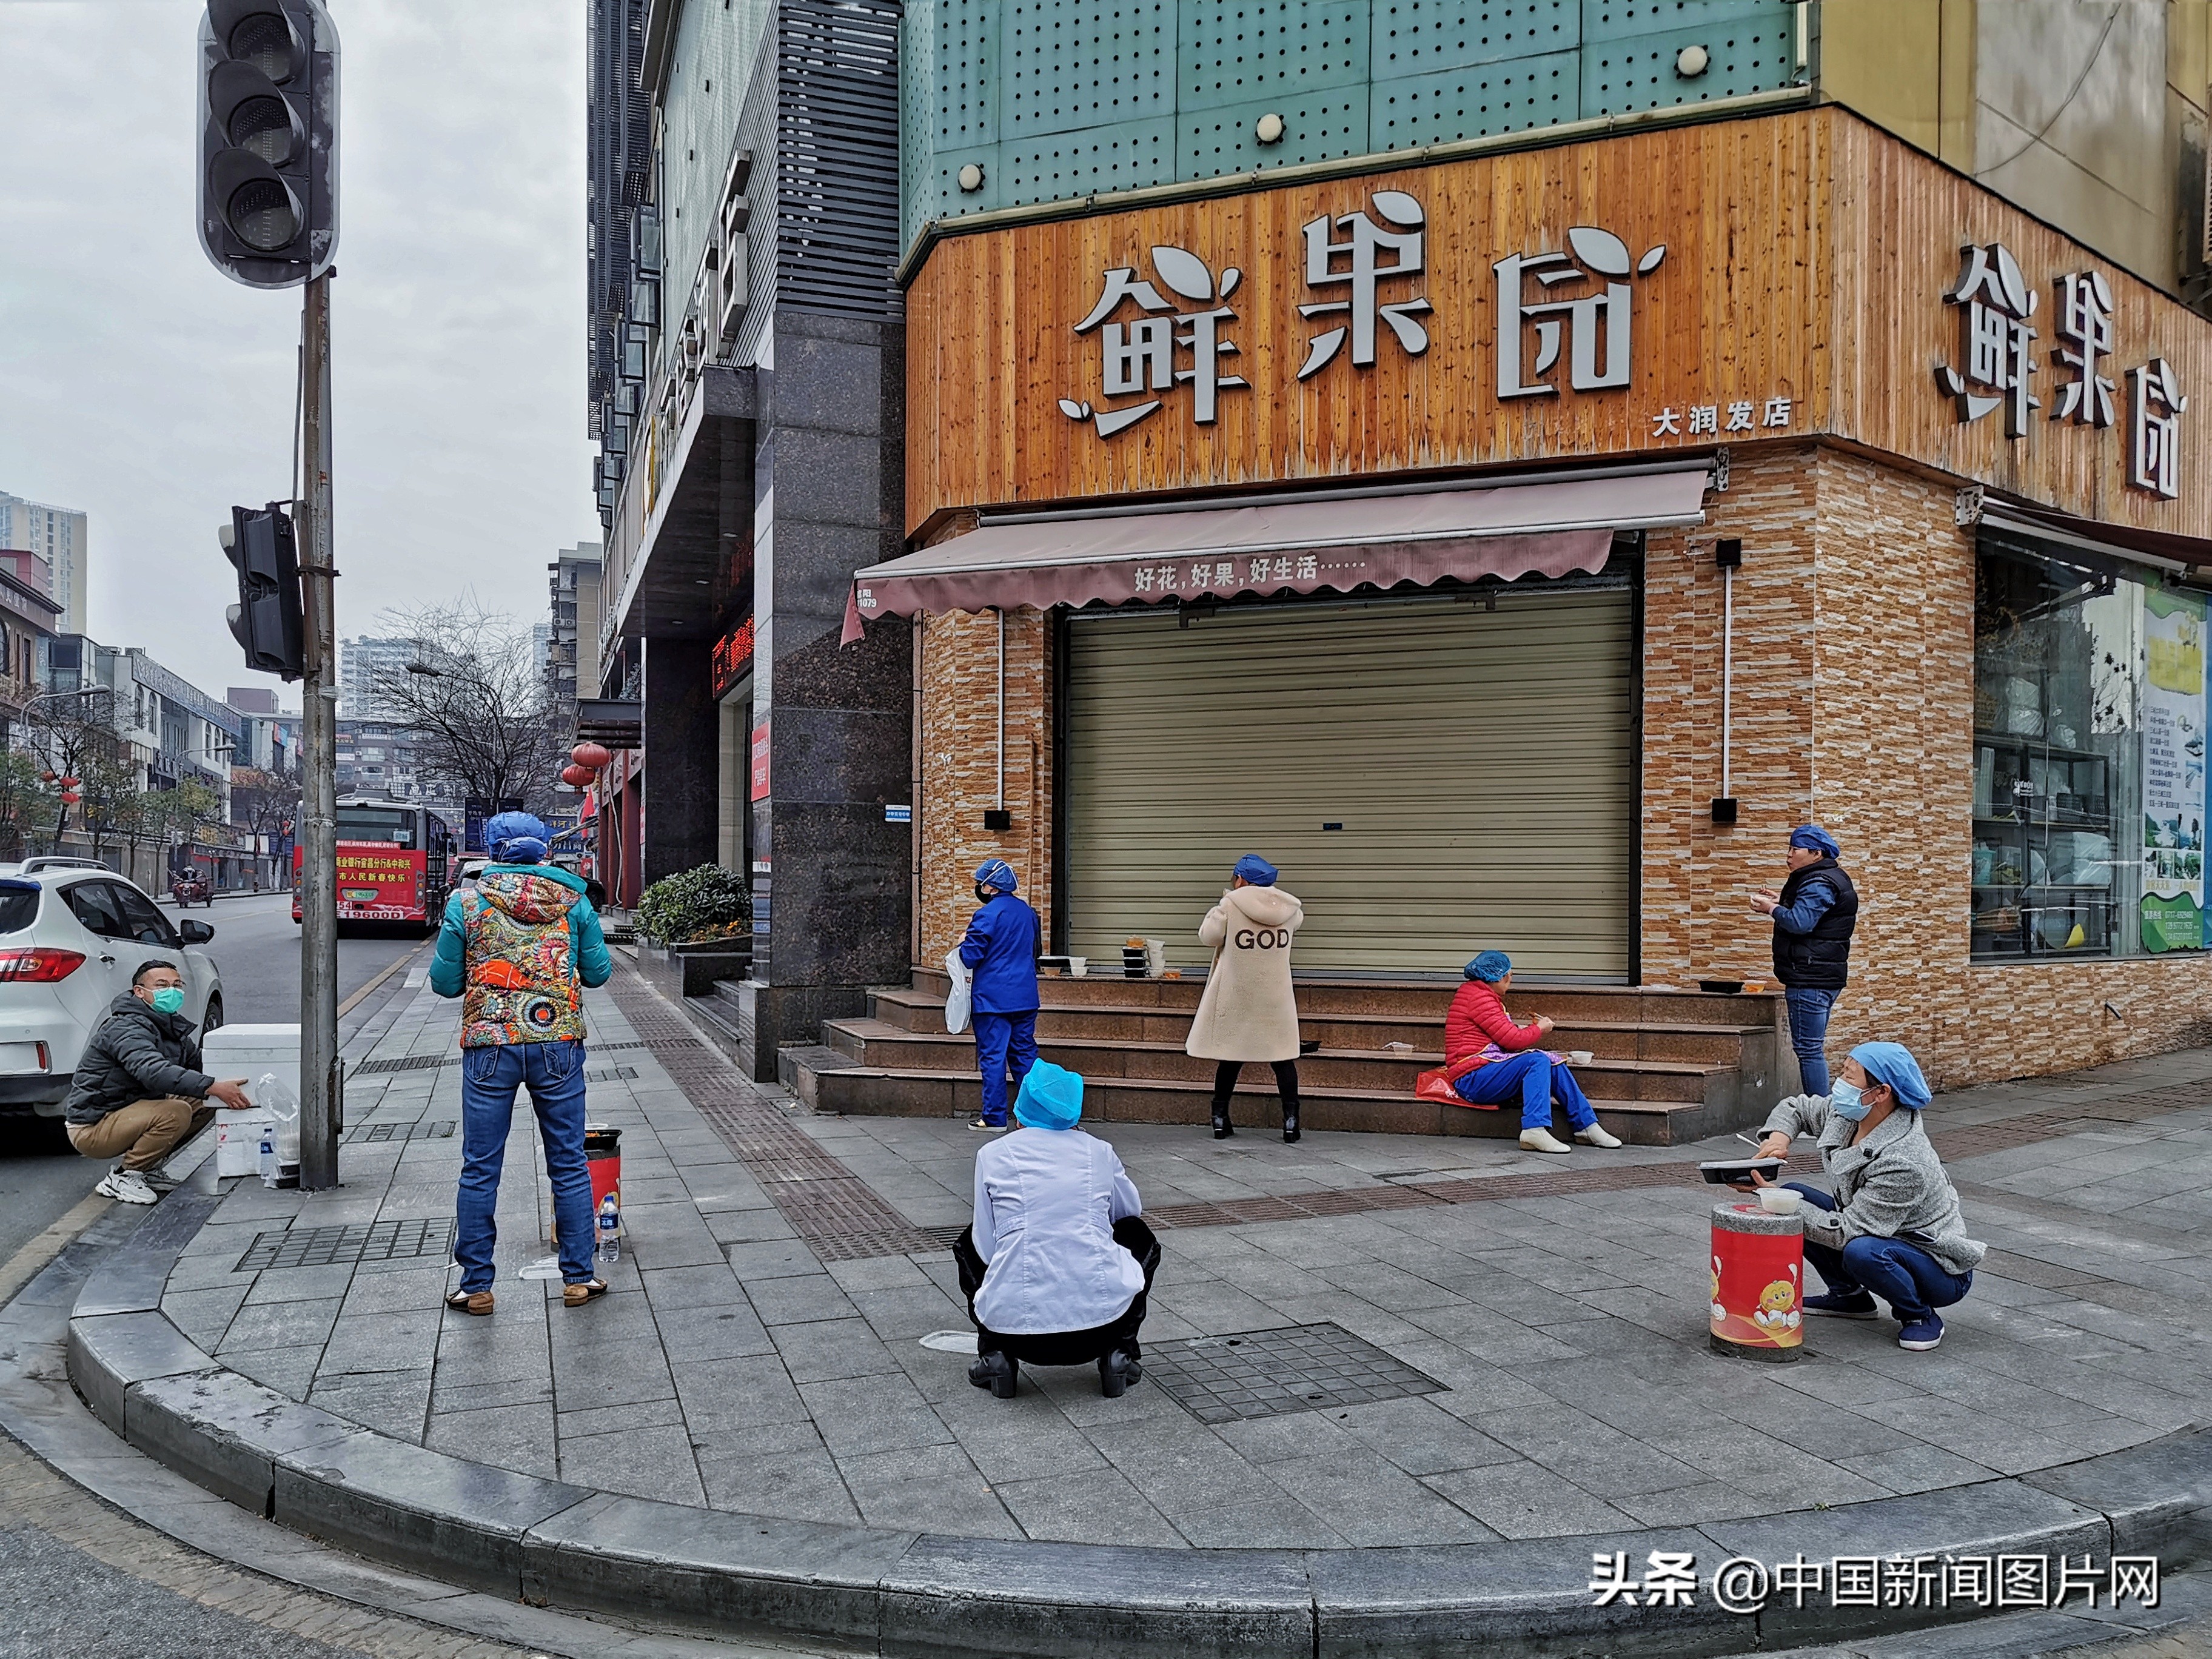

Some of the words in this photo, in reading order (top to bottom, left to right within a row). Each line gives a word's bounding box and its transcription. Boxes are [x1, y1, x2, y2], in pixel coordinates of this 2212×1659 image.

[1057, 190, 1666, 440] 鲜果园
[1934, 243, 2188, 500] 鲜果园
[1652, 397, 1792, 437] 大润发店
[1235, 929, 1289, 950] GOD
